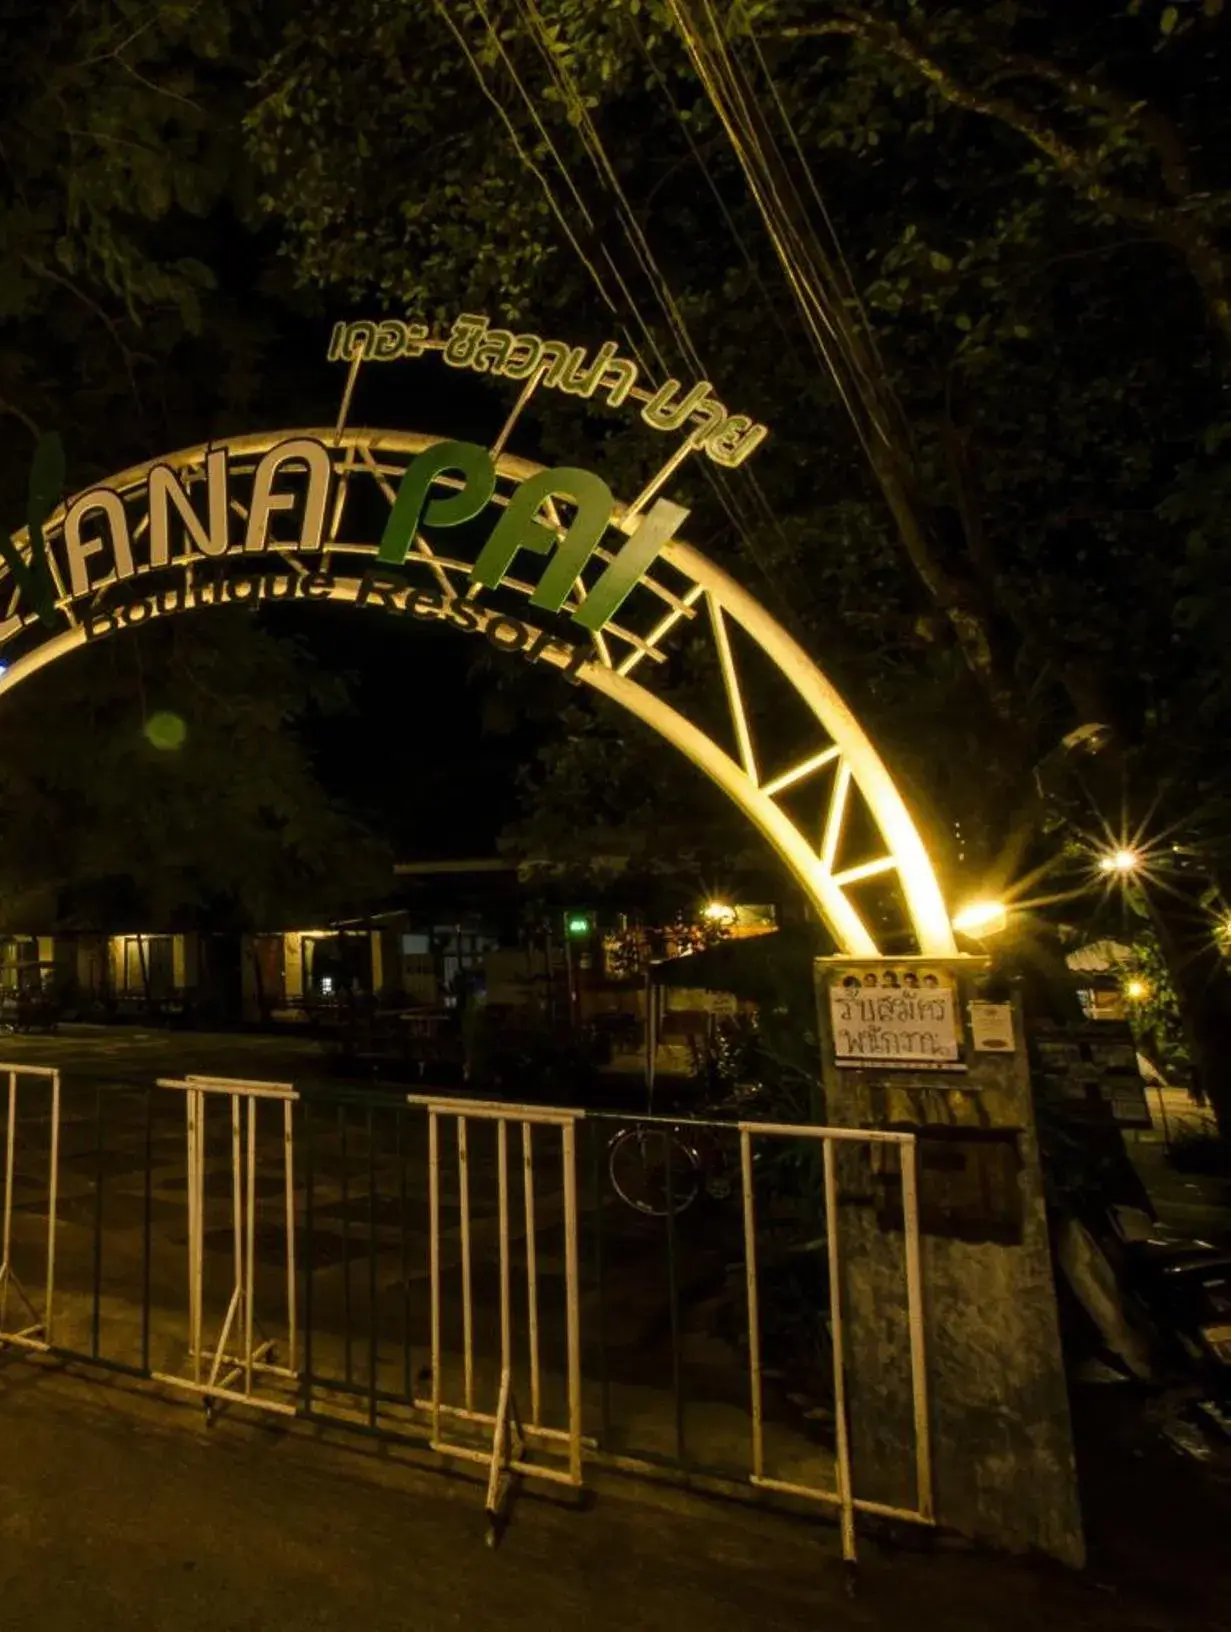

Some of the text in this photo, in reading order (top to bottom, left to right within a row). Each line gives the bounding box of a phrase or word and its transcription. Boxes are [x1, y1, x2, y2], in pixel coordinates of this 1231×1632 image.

[326, 320, 429, 363] เดอะ
[641, 378, 769, 467] ปาย
[378, 440, 690, 632] PAI
[86, 571, 596, 686] Boutique Resort
